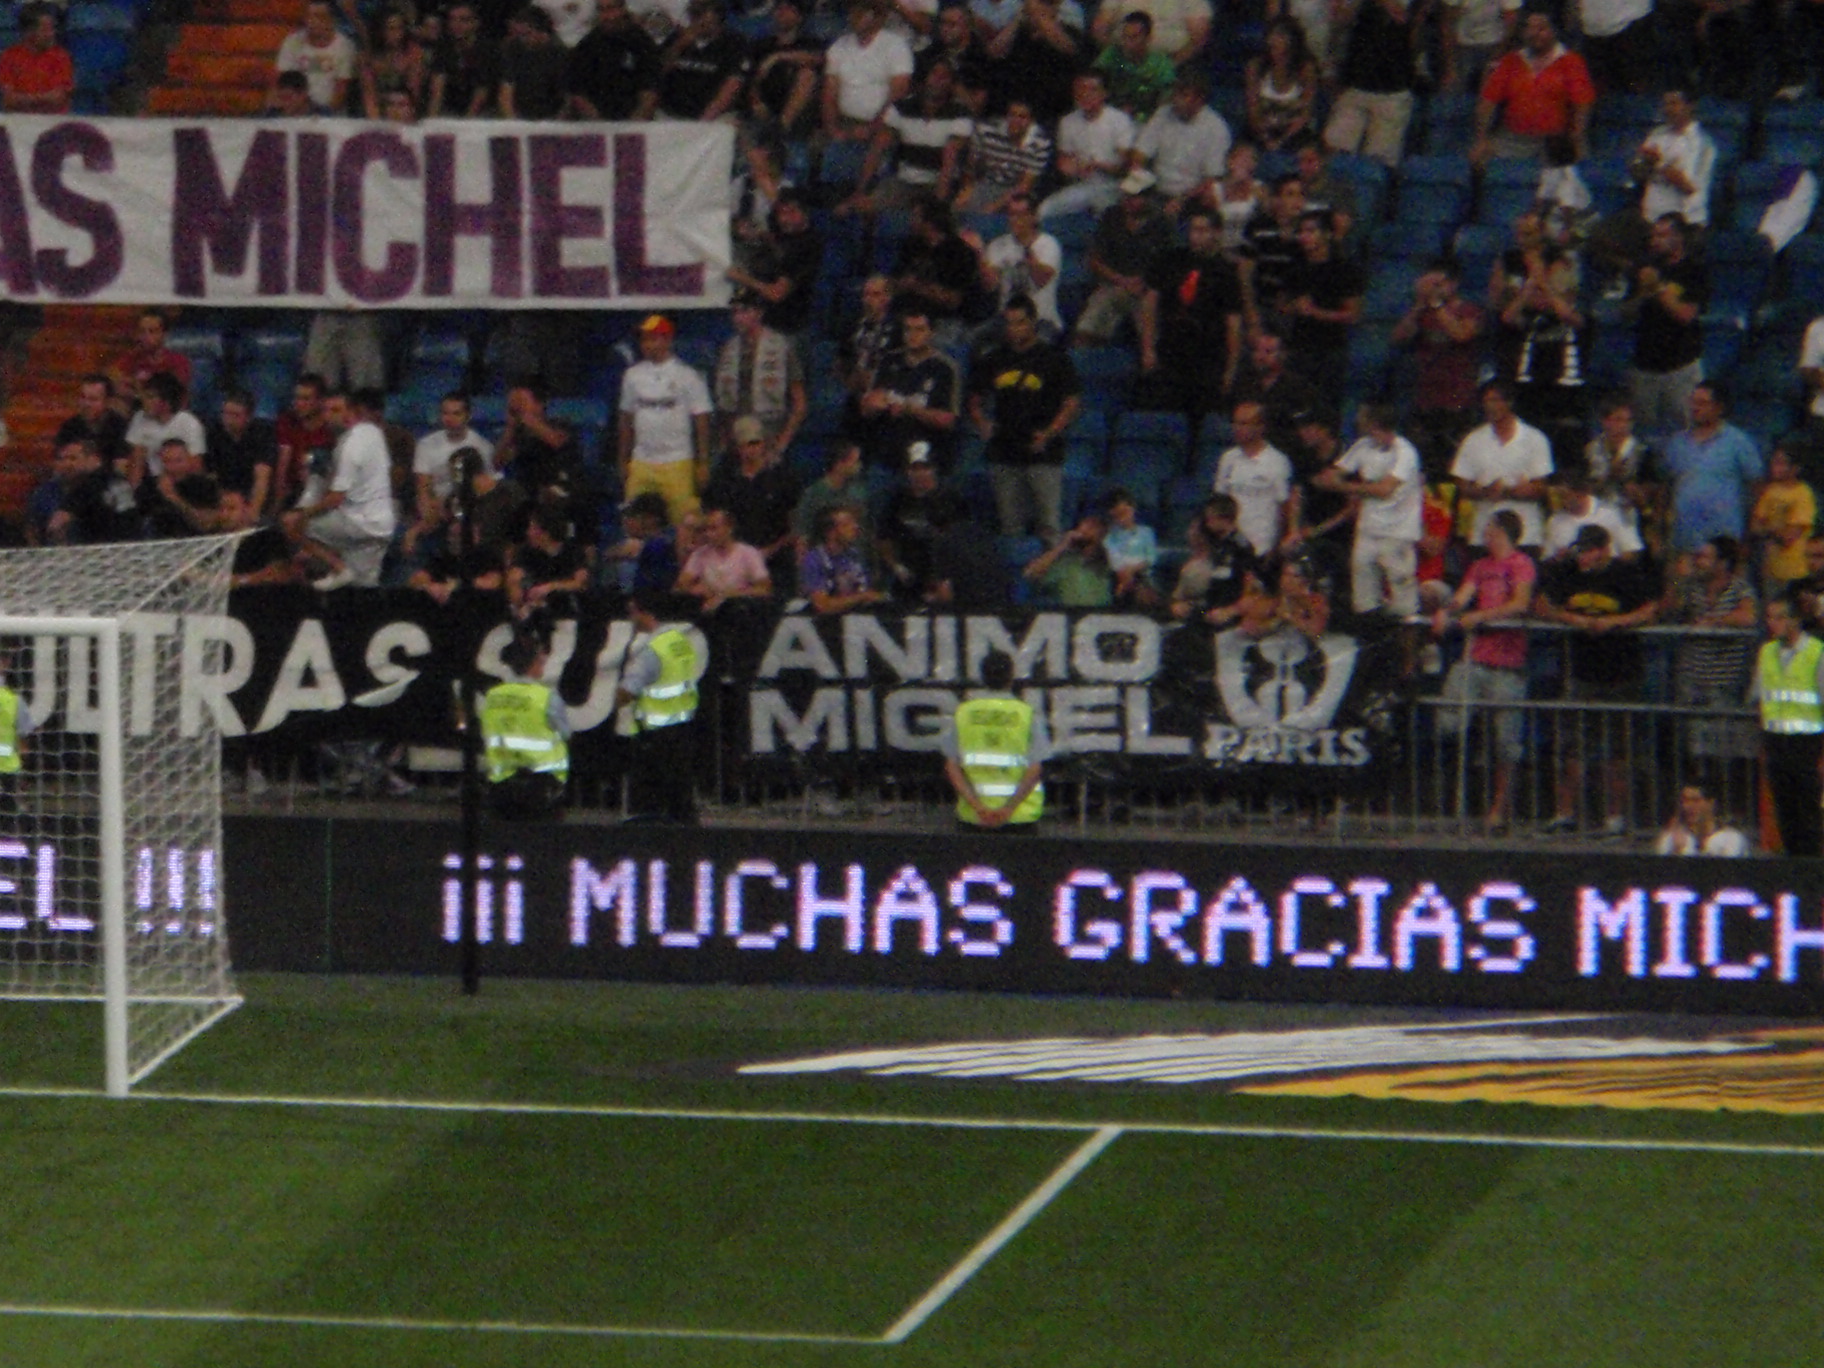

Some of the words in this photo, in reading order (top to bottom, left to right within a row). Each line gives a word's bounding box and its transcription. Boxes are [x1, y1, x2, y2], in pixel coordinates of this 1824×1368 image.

[171, 127, 706, 304] MICHEL
[756, 613, 1164, 682] ANIMO
[1203, 722, 1372, 767] PARIS
[569, 857, 1015, 957] MUCHAS
[1053, 869, 1536, 974] GRACIAS
